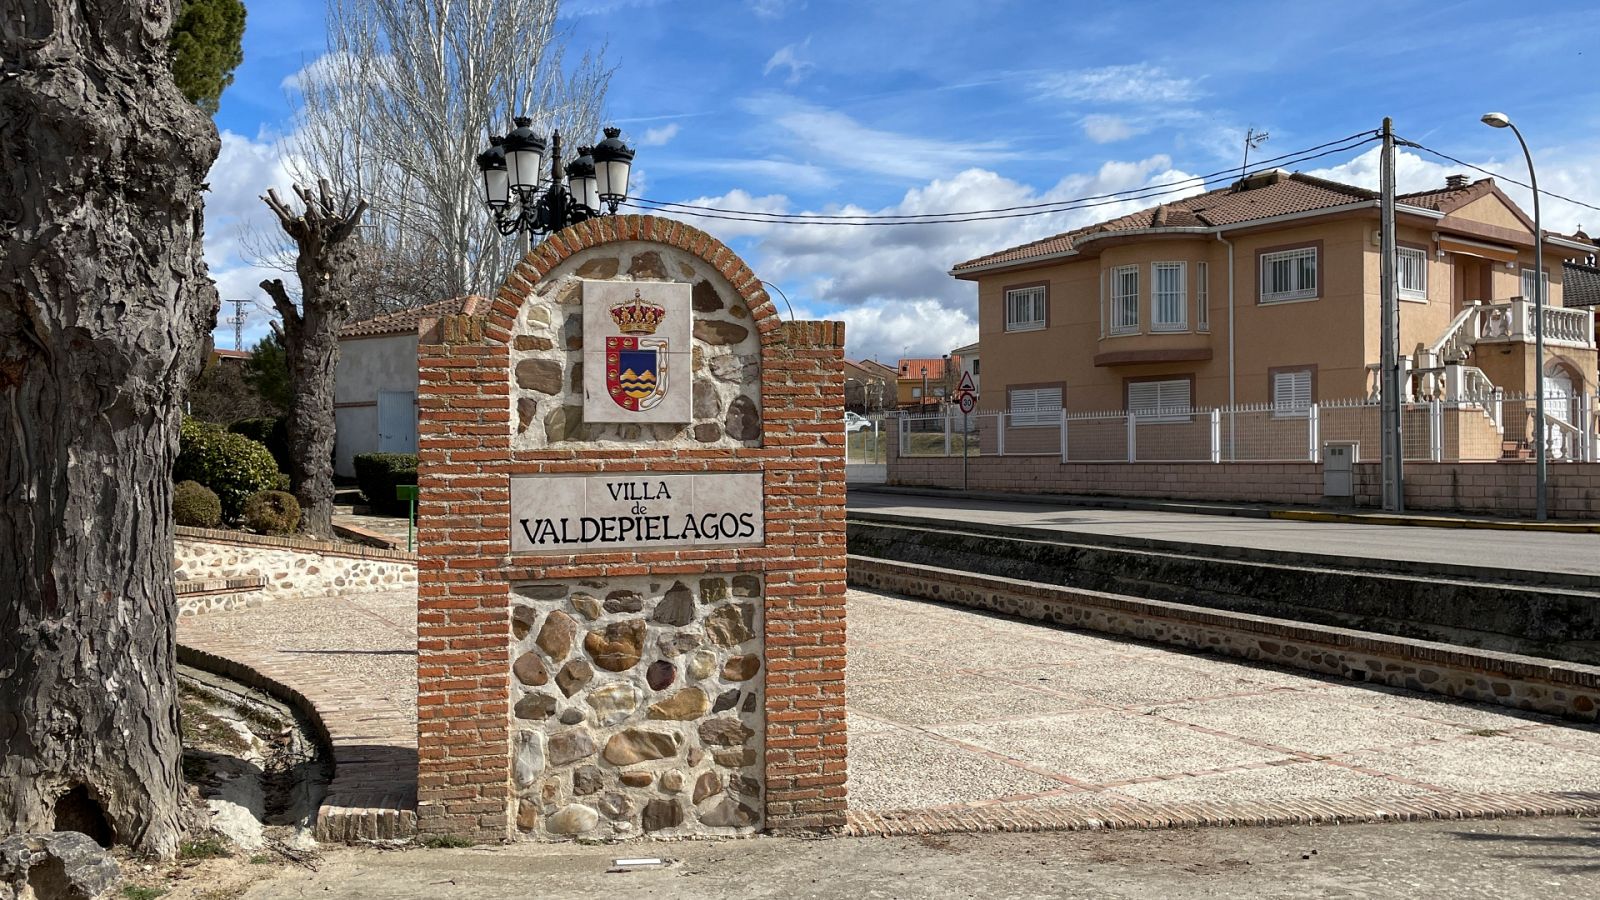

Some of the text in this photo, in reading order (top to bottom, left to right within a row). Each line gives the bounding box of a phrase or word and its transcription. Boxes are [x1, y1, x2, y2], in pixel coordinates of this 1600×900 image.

[963, 398, 972, 406] 30
[606, 481, 671, 501] VILLA
[631, 501, 647, 515] de
[519, 512, 755, 545] VALDEPIELAGOS
